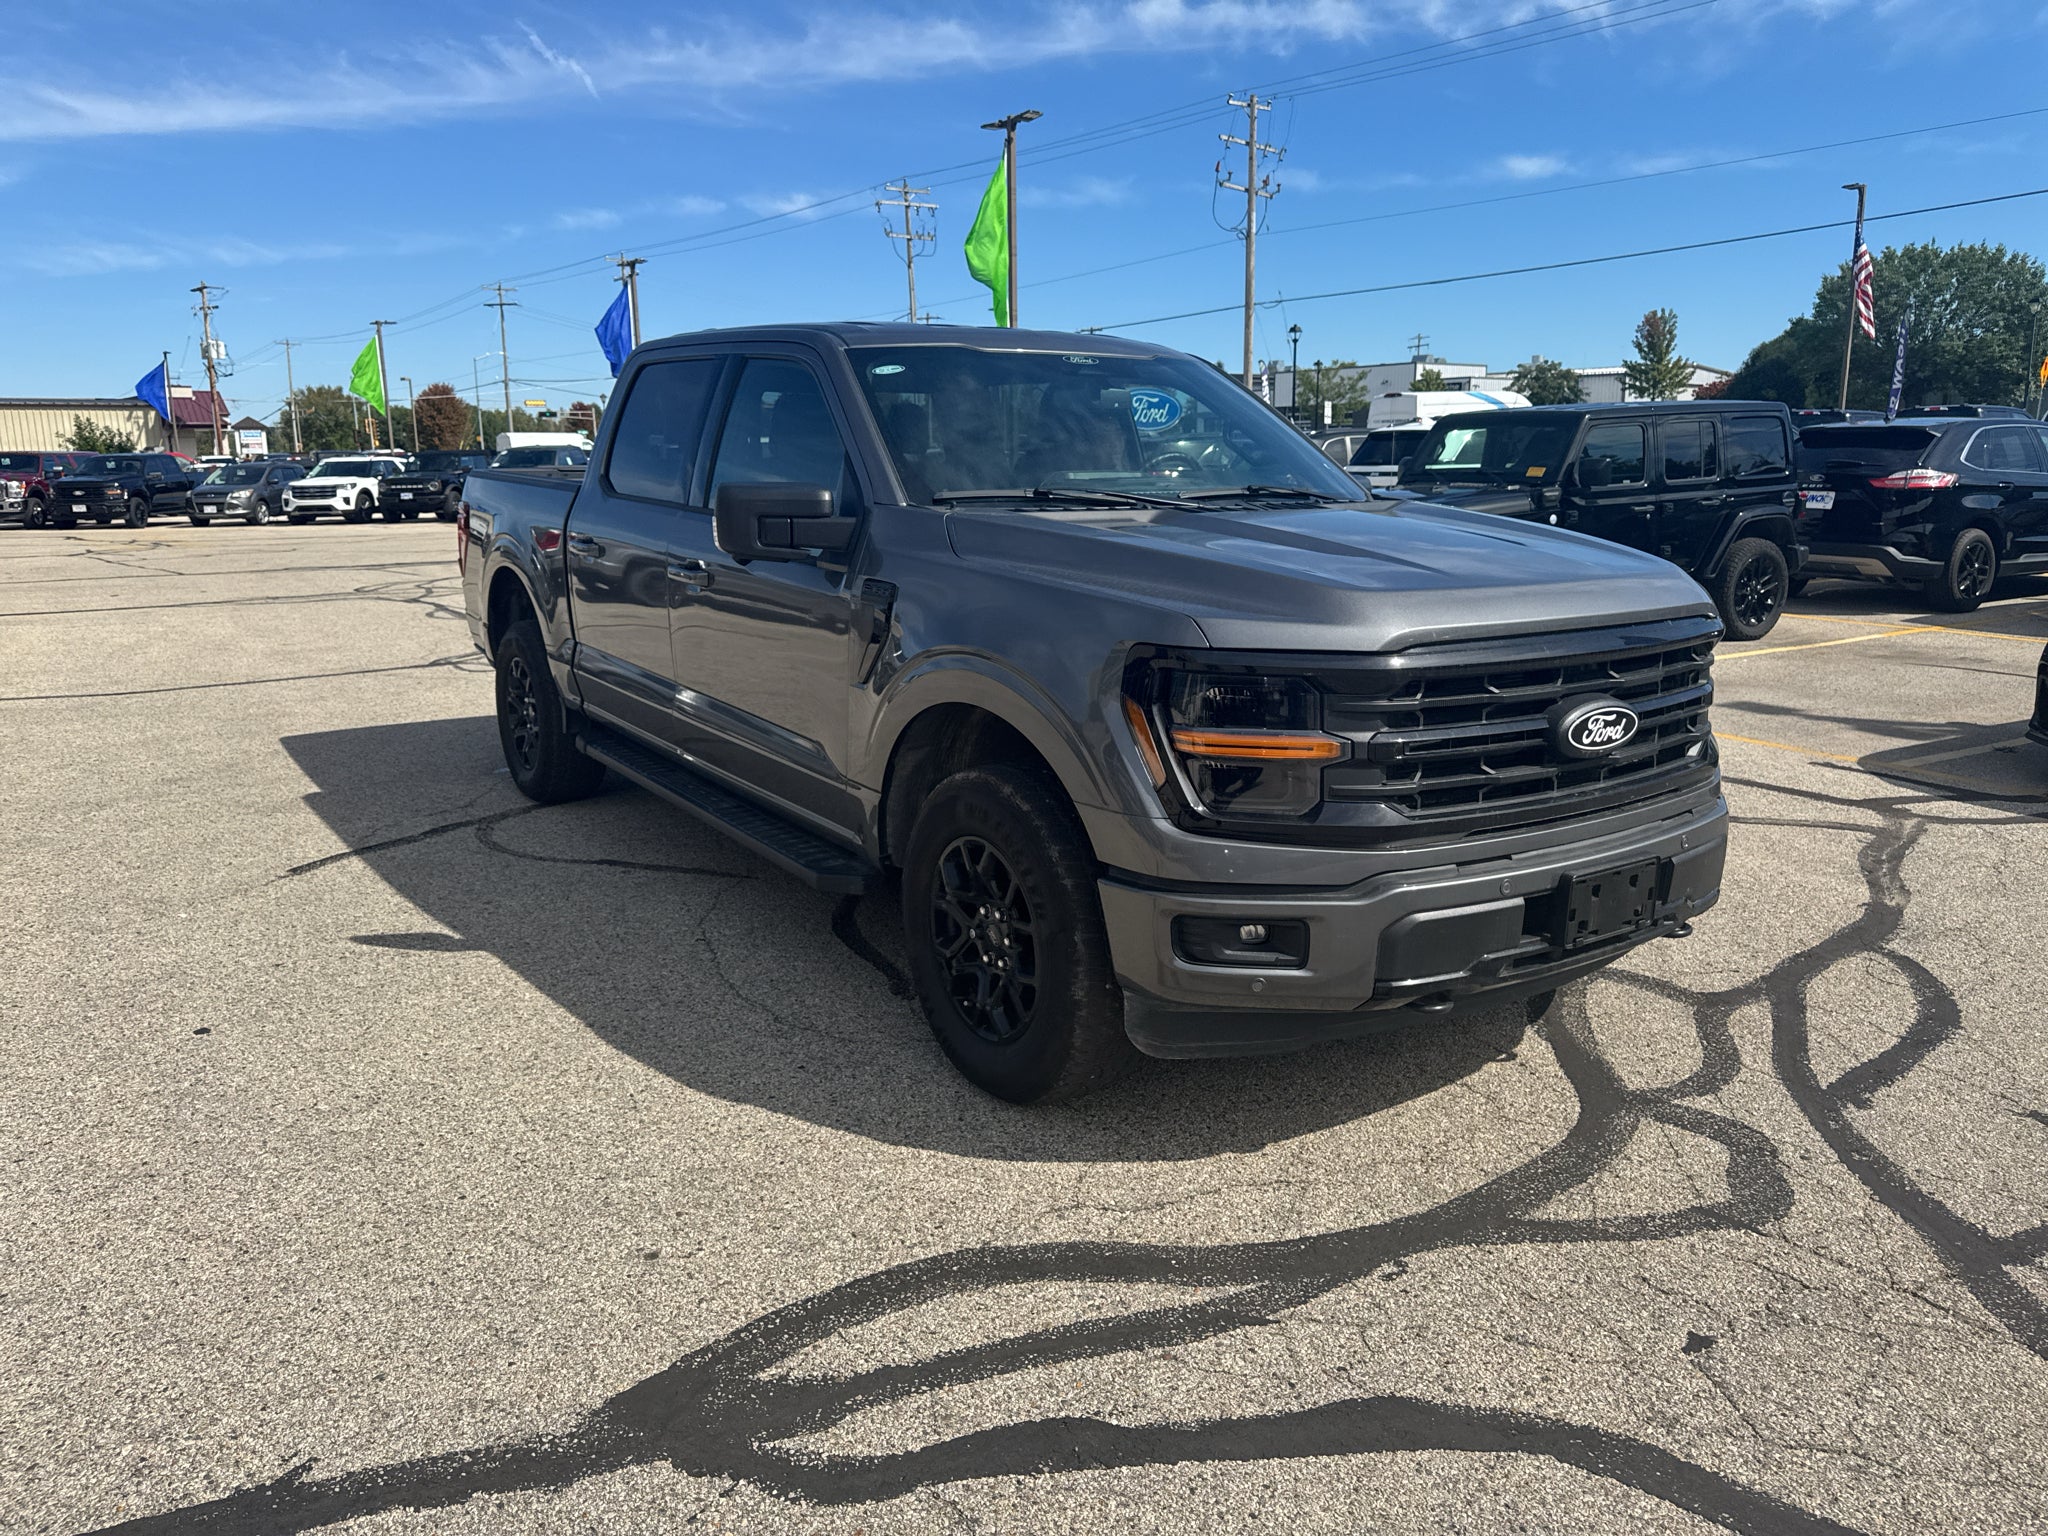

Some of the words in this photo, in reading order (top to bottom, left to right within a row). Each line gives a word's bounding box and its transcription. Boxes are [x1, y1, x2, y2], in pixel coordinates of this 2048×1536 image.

[1261, 373, 1271, 405] ASH
[1132, 395, 1170, 423] Ford
[1582, 713, 1627, 745] Ford
